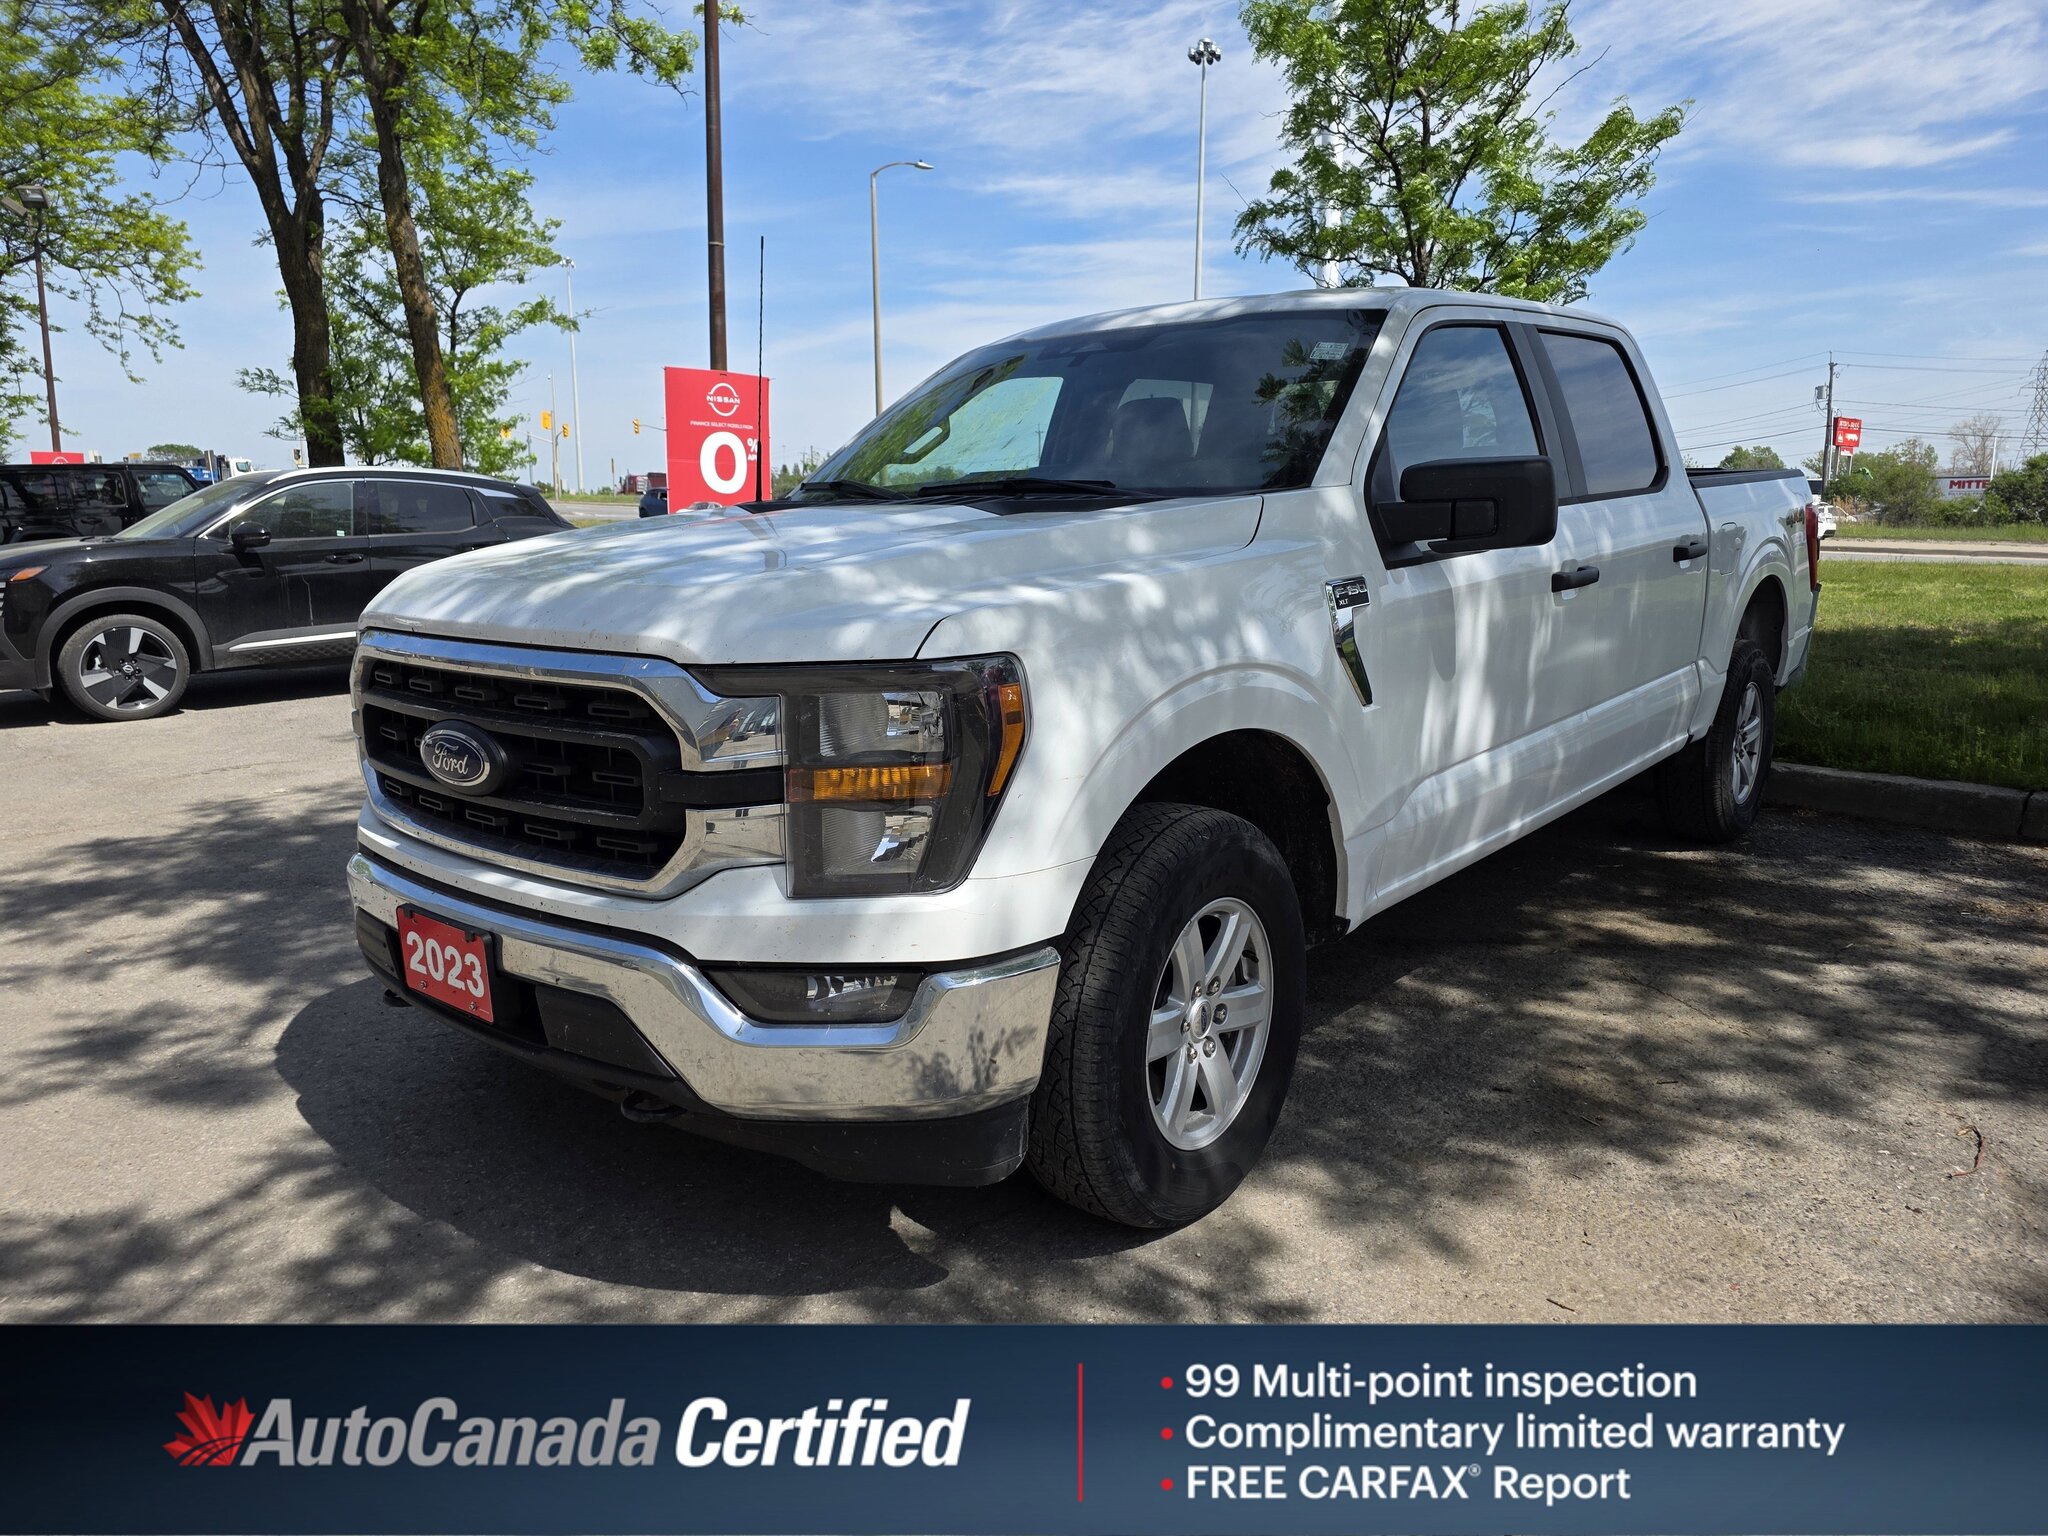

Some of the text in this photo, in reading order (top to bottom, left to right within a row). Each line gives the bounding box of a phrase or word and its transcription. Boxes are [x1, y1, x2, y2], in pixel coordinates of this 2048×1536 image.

[706, 394, 740, 404] NISSAN
[700, 431, 747, 494] 0
[1339, 598, 1349, 606] XLT
[432, 741, 469, 775] Ford
[406, 930, 485, 998] 2023
